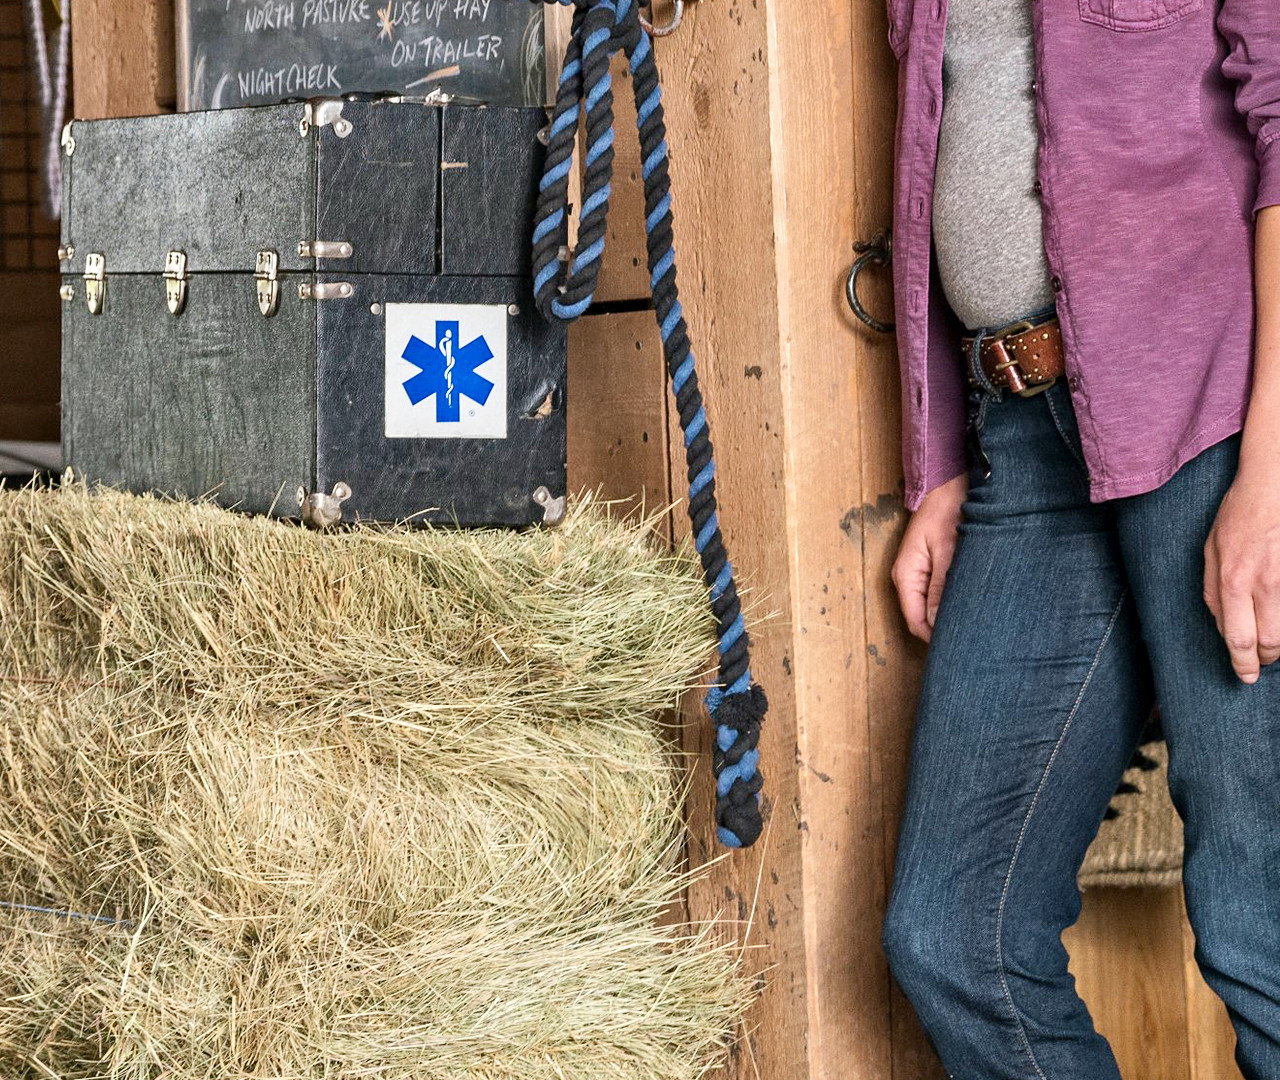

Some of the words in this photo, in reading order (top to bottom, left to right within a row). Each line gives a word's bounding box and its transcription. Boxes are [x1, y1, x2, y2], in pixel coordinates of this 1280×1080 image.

[245, 0, 294, 33] NORTH
[393, 0, 421, 26] USE
[391, 40, 416, 67] ON
